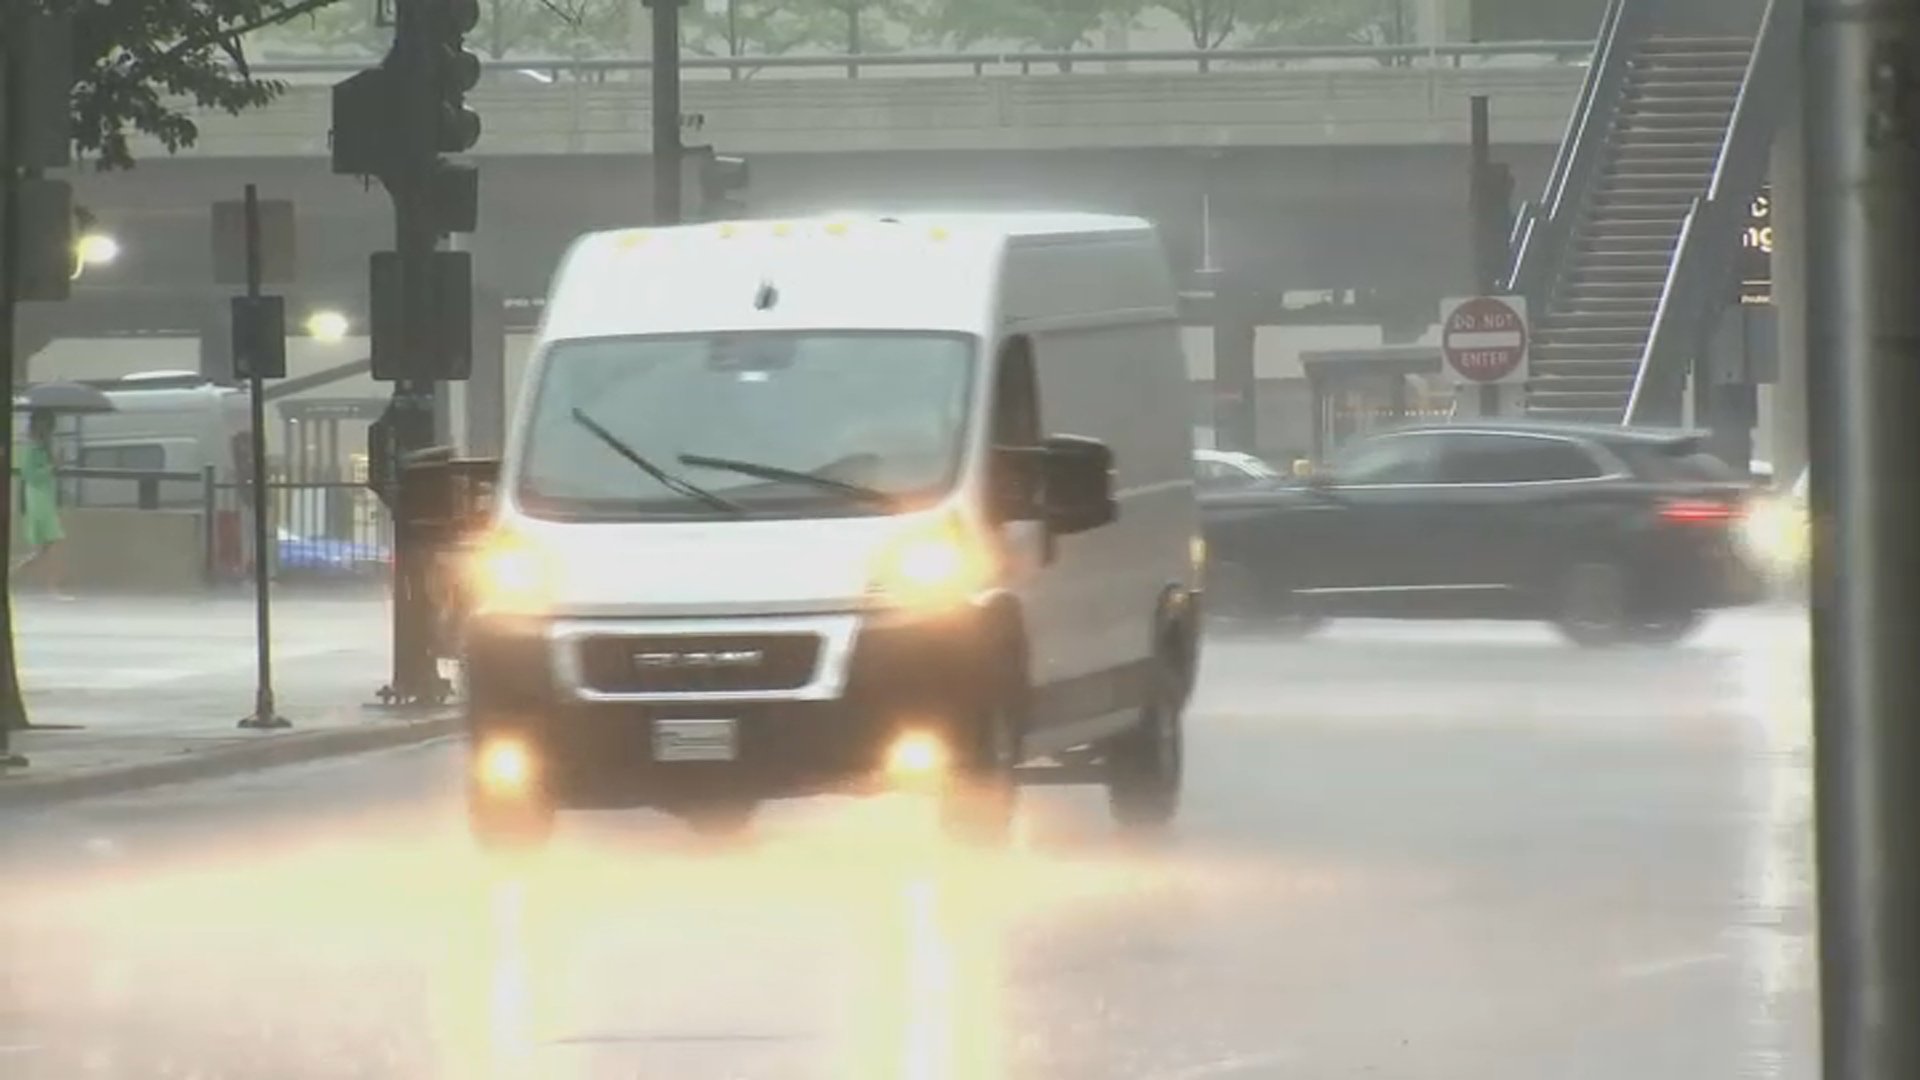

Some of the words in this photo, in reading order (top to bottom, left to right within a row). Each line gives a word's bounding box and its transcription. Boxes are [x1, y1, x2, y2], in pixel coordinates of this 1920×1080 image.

[1454, 313, 1476, 330] DO
[1483, 312, 1514, 329] NOT
[1461, 351, 1508, 368] ENTER
